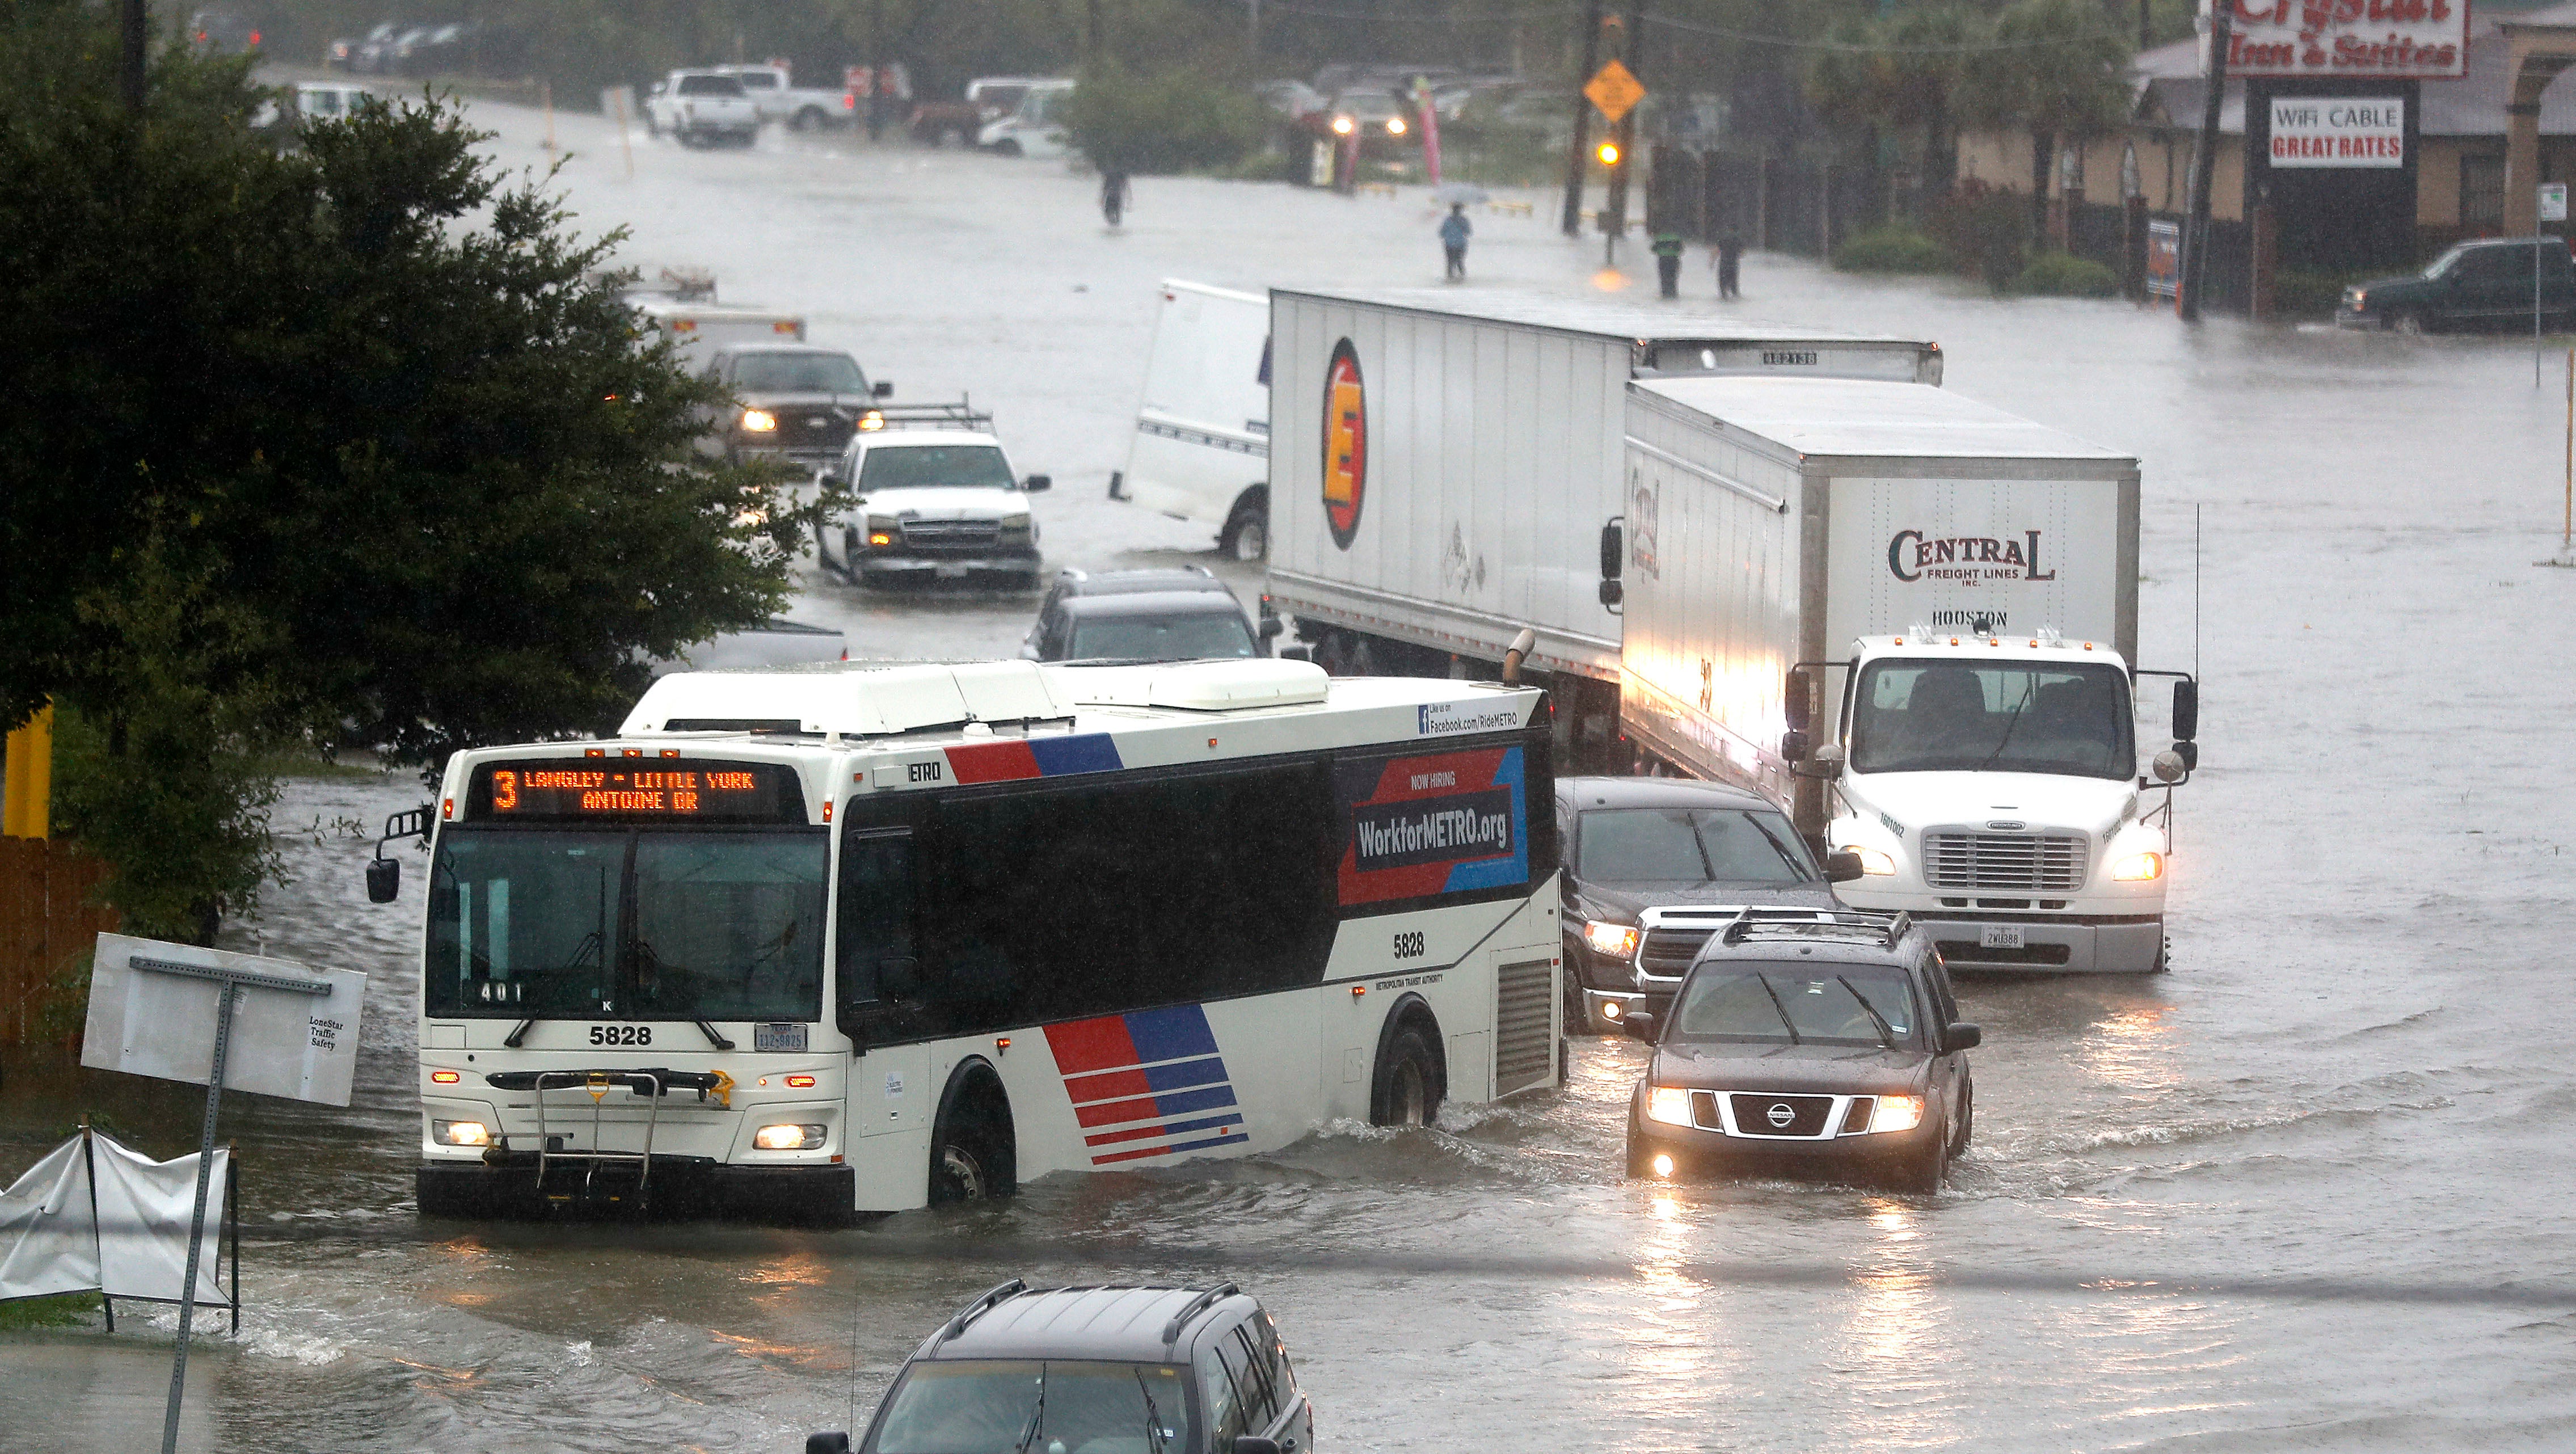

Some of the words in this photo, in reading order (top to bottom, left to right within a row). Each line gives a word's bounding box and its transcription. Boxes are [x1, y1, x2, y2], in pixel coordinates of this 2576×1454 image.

[2229, 33, 2294, 66] Inn
[2333, 33, 2457, 67] Suites
[2330, 107, 2397, 128] CABLE
[2273, 136, 2334, 158] GREAT
[2339, 136, 2400, 159] RATES
[1888, 530, 2056, 583] CENTRAL
[1927, 569, 1980, 579] FREIGHT
[1984, 569, 2019, 579] LINES
[1932, 610, 2008, 626] HOUSTON
[1430, 703, 1438, 713] Like
[1430, 712, 1517, 734] Facebook.com/RideMETRO
[524, 771, 605, 787] LANGLEY
[634, 772, 698, 789] LITTLE
[907, 762, 941, 783] ETRO
[1411, 774, 1428, 790] NOW
[1430, 770, 1456, 788] HIRING
[495, 771, 517, 808] 3
[583, 791, 664, 810] ANTOINE
[673, 792, 698, 810] DR
[1359, 808, 1507, 857] WorkforMETRO.org
[1881, 812, 1904, 838] 1601002
[1394, 932, 1424, 959] 5828
[1405, 976, 1422, 987] TRANSIT
[1422, 973, 1443, 984] AUTHORITY
[481, 983, 521, 1002] 401
[602, 1001, 612, 1012] K
[309, 1016, 344, 1030] LoneStar
[311, 1026, 336, 1039] Traffic
[311, 1038, 335, 1052] Safety
[589, 1026, 652, 1046] 5828
